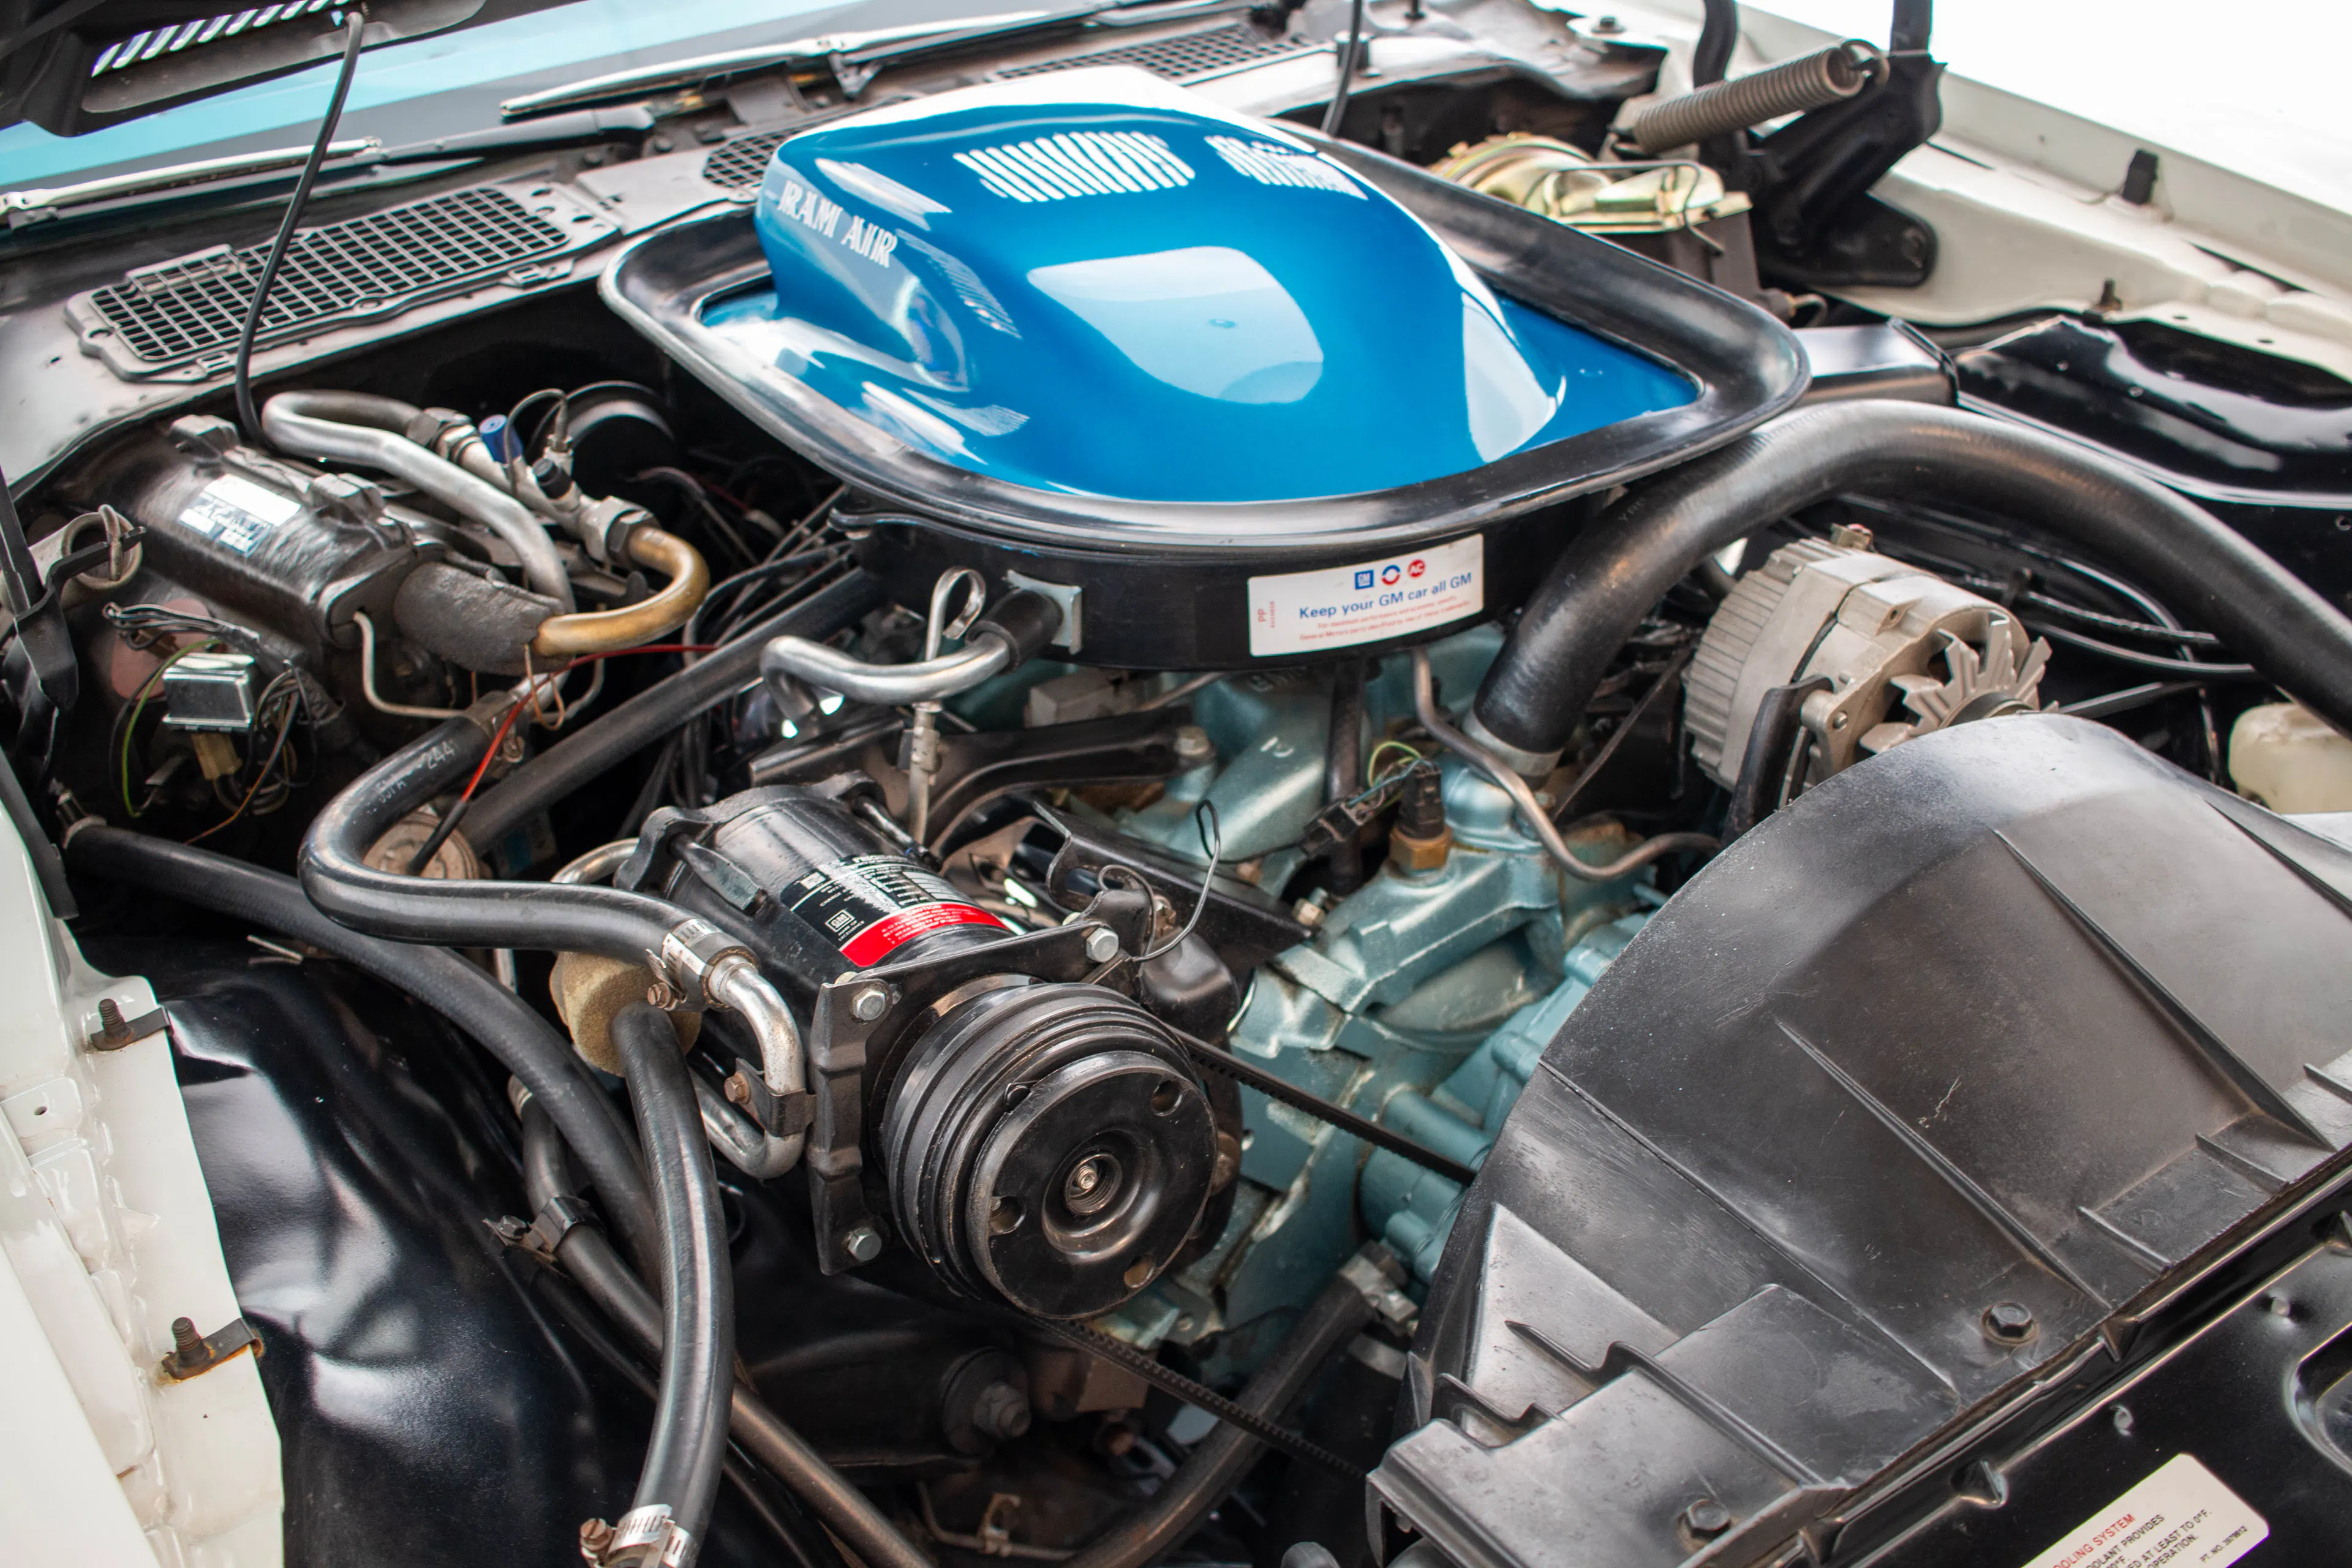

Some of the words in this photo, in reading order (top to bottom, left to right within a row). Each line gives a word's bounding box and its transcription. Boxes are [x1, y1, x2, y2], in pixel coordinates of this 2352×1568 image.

[777, 180, 844, 239] RAM
[841, 214, 899, 268] AIR
[1299, 606, 1337, 619] Keep
[1341, 600, 1374, 616] your
[1379, 591, 1404, 606] GM
[1408, 588, 1428, 600] car
[1431, 581, 1446, 595] all
[1450, 572, 1472, 589] GM
[831, 913, 849, 927] GM
[2092, 1513, 2136, 1546] SYSTEM
[2120, 1514, 2165, 1547] PROVIDES
[2141, 1550, 2154, 1562] AT
[2153, 1529, 2181, 1553] LEAST
[2179, 1521, 2194, 1532] TO
